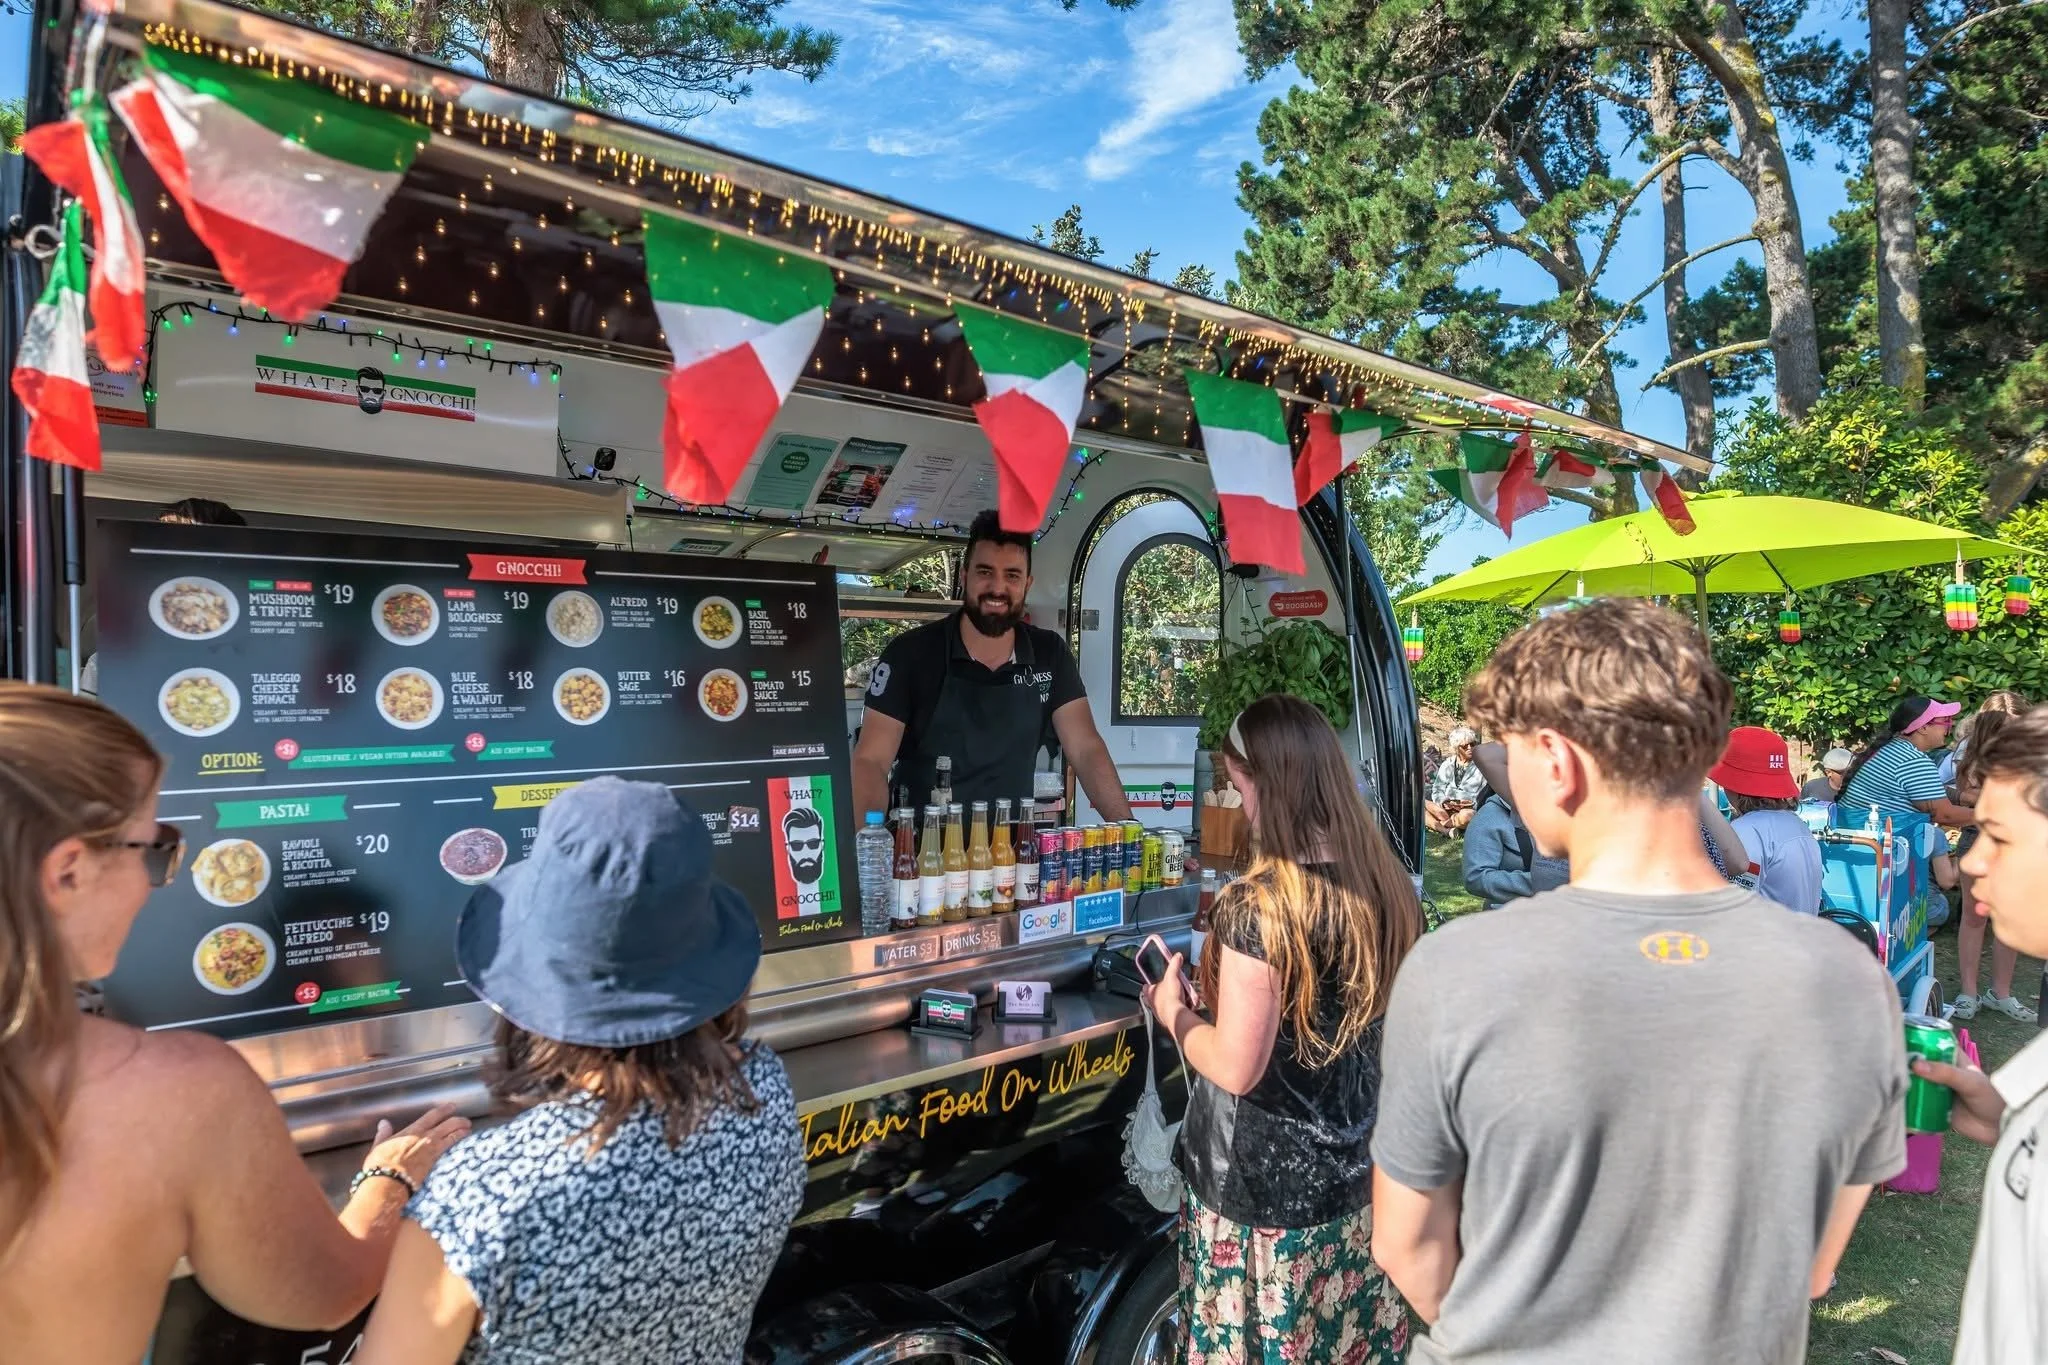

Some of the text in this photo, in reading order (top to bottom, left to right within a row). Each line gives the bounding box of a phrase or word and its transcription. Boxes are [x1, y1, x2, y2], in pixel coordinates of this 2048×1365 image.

[257, 367, 476, 411] WHAT? GNOCCHI!
[496, 561, 562, 577] GNOCCHI!
[249, 593, 316, 606] MUSHROOM
[324, 584, 354, 604] $19
[503, 591, 529, 610] $19
[447, 600, 476, 612] LAMB
[610, 596, 648, 607] ALFREDO
[656, 597, 679, 615] $19
[249, 606, 313, 618] & TRUFFLE
[748, 610, 769, 620] BASIL
[787, 602, 807, 619] $18
[447, 612, 503, 624] BOLOGNESE
[748, 620, 772, 630] PESTO
[251, 673, 301, 683] TALEGGIO
[450, 671, 477, 682] BLUE
[508, 671, 534, 690] $18
[617, 671, 651, 681] BUTTER
[664, 669, 686, 687] $16
[791, 670, 812, 687] $15
[252, 684, 291, 694] CHEESE
[326, 673, 357, 694] $18
[451, 683, 490, 694] CHEESE
[618, 682, 640, 692] SAGE
[753, 681, 785, 691] TOMATO
[252, 694, 297, 705] SPINACH
[452, 694, 504, 705] & WALNUT
[754, 691, 779, 701] SAUCE
[201, 752, 263, 769] OPTION:
[783, 788, 823, 800] WHAT?
[260, 804, 310, 819] PASTA!
[730, 811, 759, 829] $14
[282, 838, 320, 850] RAVIOLI
[356, 834, 389, 854] $20
[282, 848, 324, 860] SPINACH
[282, 858, 332, 871] & RICOTTA
[782, 890, 834, 907] GNOCCHI!
[284, 916, 354, 935] FETTUCCINE
[360, 911, 390, 933] $19
[1023, 909, 1067, 929] Google
[1088, 914, 1114, 925] facebook
[285, 931, 334, 947] ALFREDO
[945, 933, 981, 952] DRINKS
[882, 942, 932, 961] WATER $3
[919, 1065, 994, 1138] Food
[1001, 1069, 1041, 1112] On
[1049, 1031, 1134, 1095] Wheels
